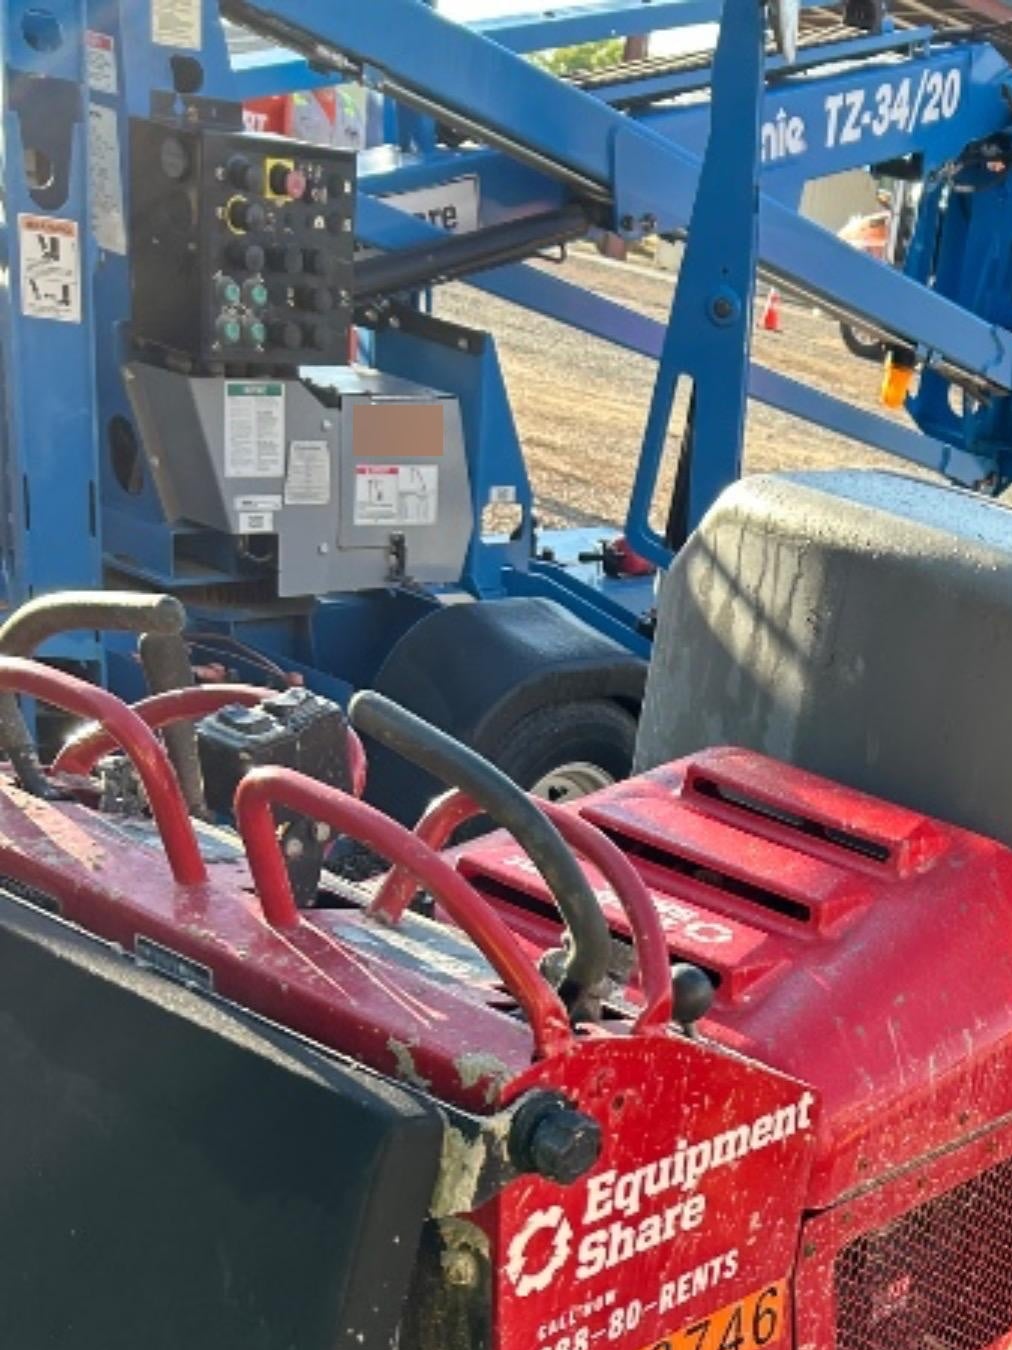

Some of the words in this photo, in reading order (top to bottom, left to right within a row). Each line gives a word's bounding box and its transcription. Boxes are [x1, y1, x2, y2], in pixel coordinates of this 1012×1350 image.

[761, 107, 807, 163] nie
[824, 68, 961, 148] TZ-34/20
[581, 1091, 814, 1226] Equipment
[575, 1193, 706, 1280] Share
